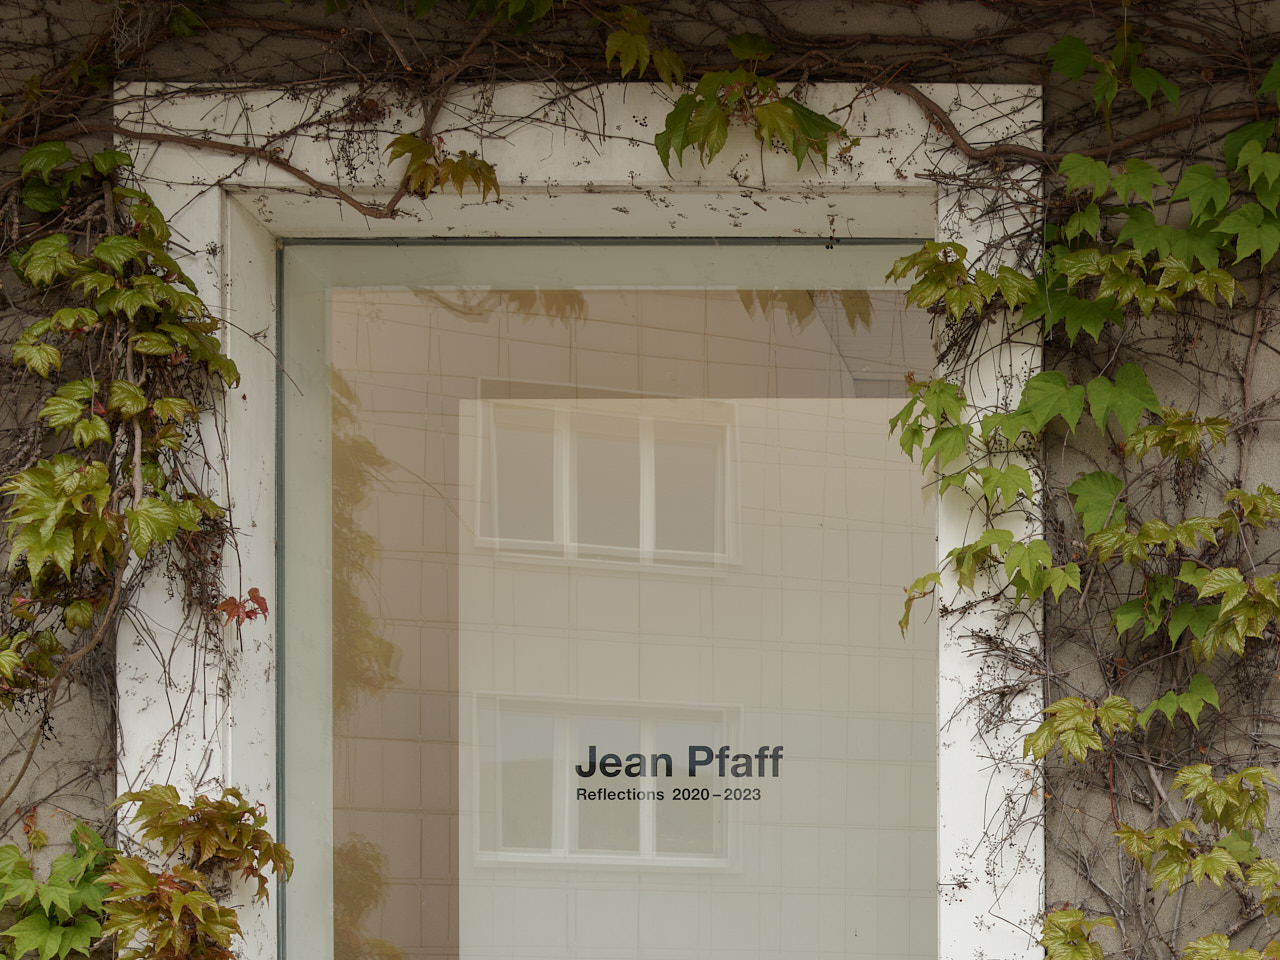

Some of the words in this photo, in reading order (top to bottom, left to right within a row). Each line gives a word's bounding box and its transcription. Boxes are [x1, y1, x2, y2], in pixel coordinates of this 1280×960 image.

[575, 745, 673, 777] Jean
[688, 745, 784, 777] Pfaff
[576, 788, 664, 801] Reflections
